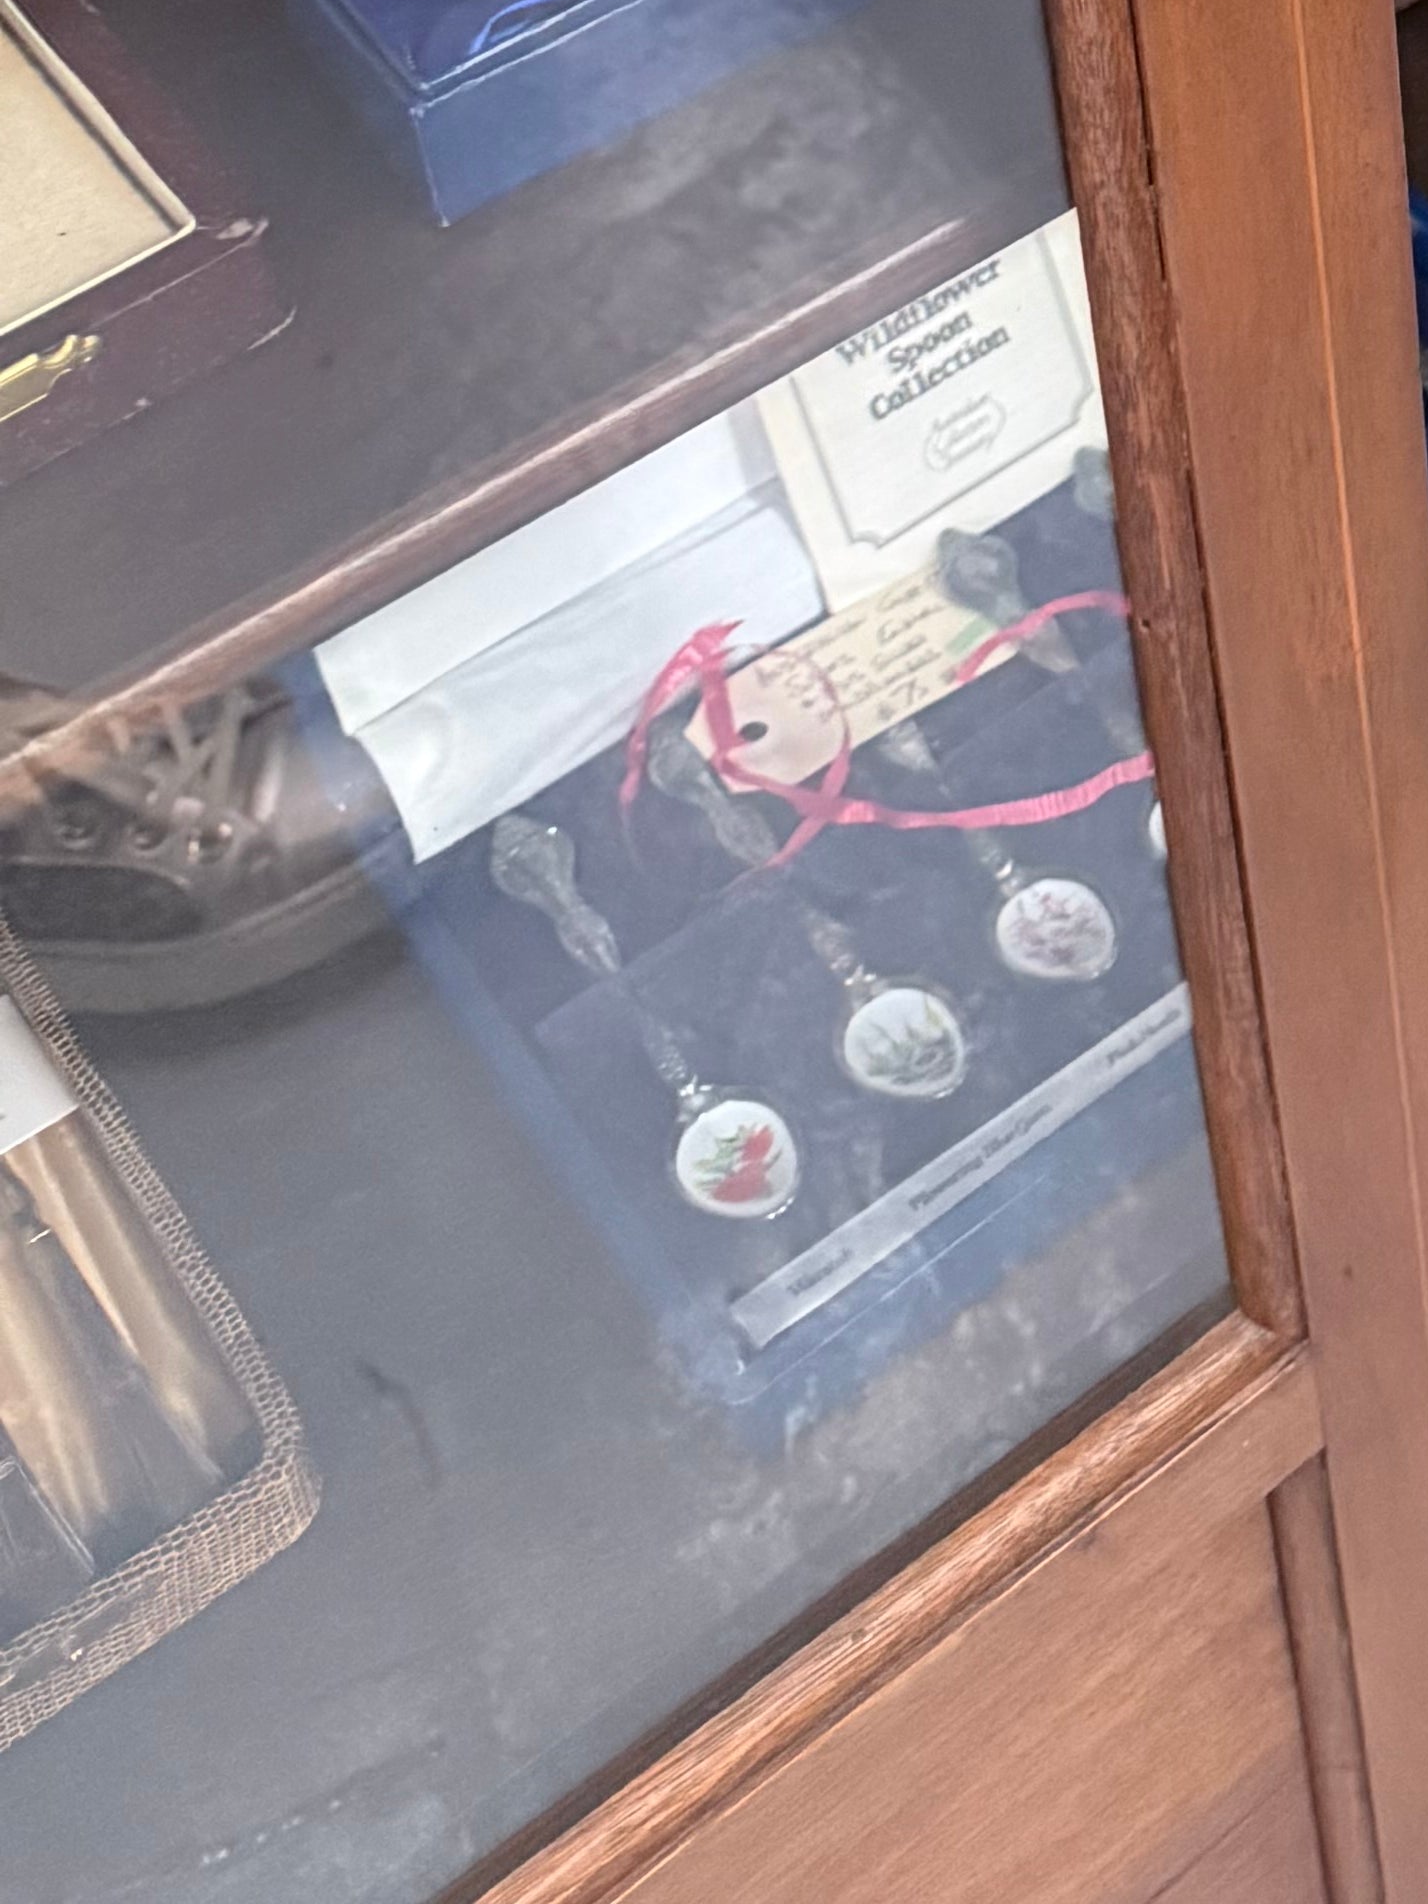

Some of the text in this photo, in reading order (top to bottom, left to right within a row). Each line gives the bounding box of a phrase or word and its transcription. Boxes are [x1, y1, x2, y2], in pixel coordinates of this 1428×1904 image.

[834, 257, 1001, 364] Wildflower
[886, 311, 972, 374] Spoon
[868, 327, 1010, 421] Collection
